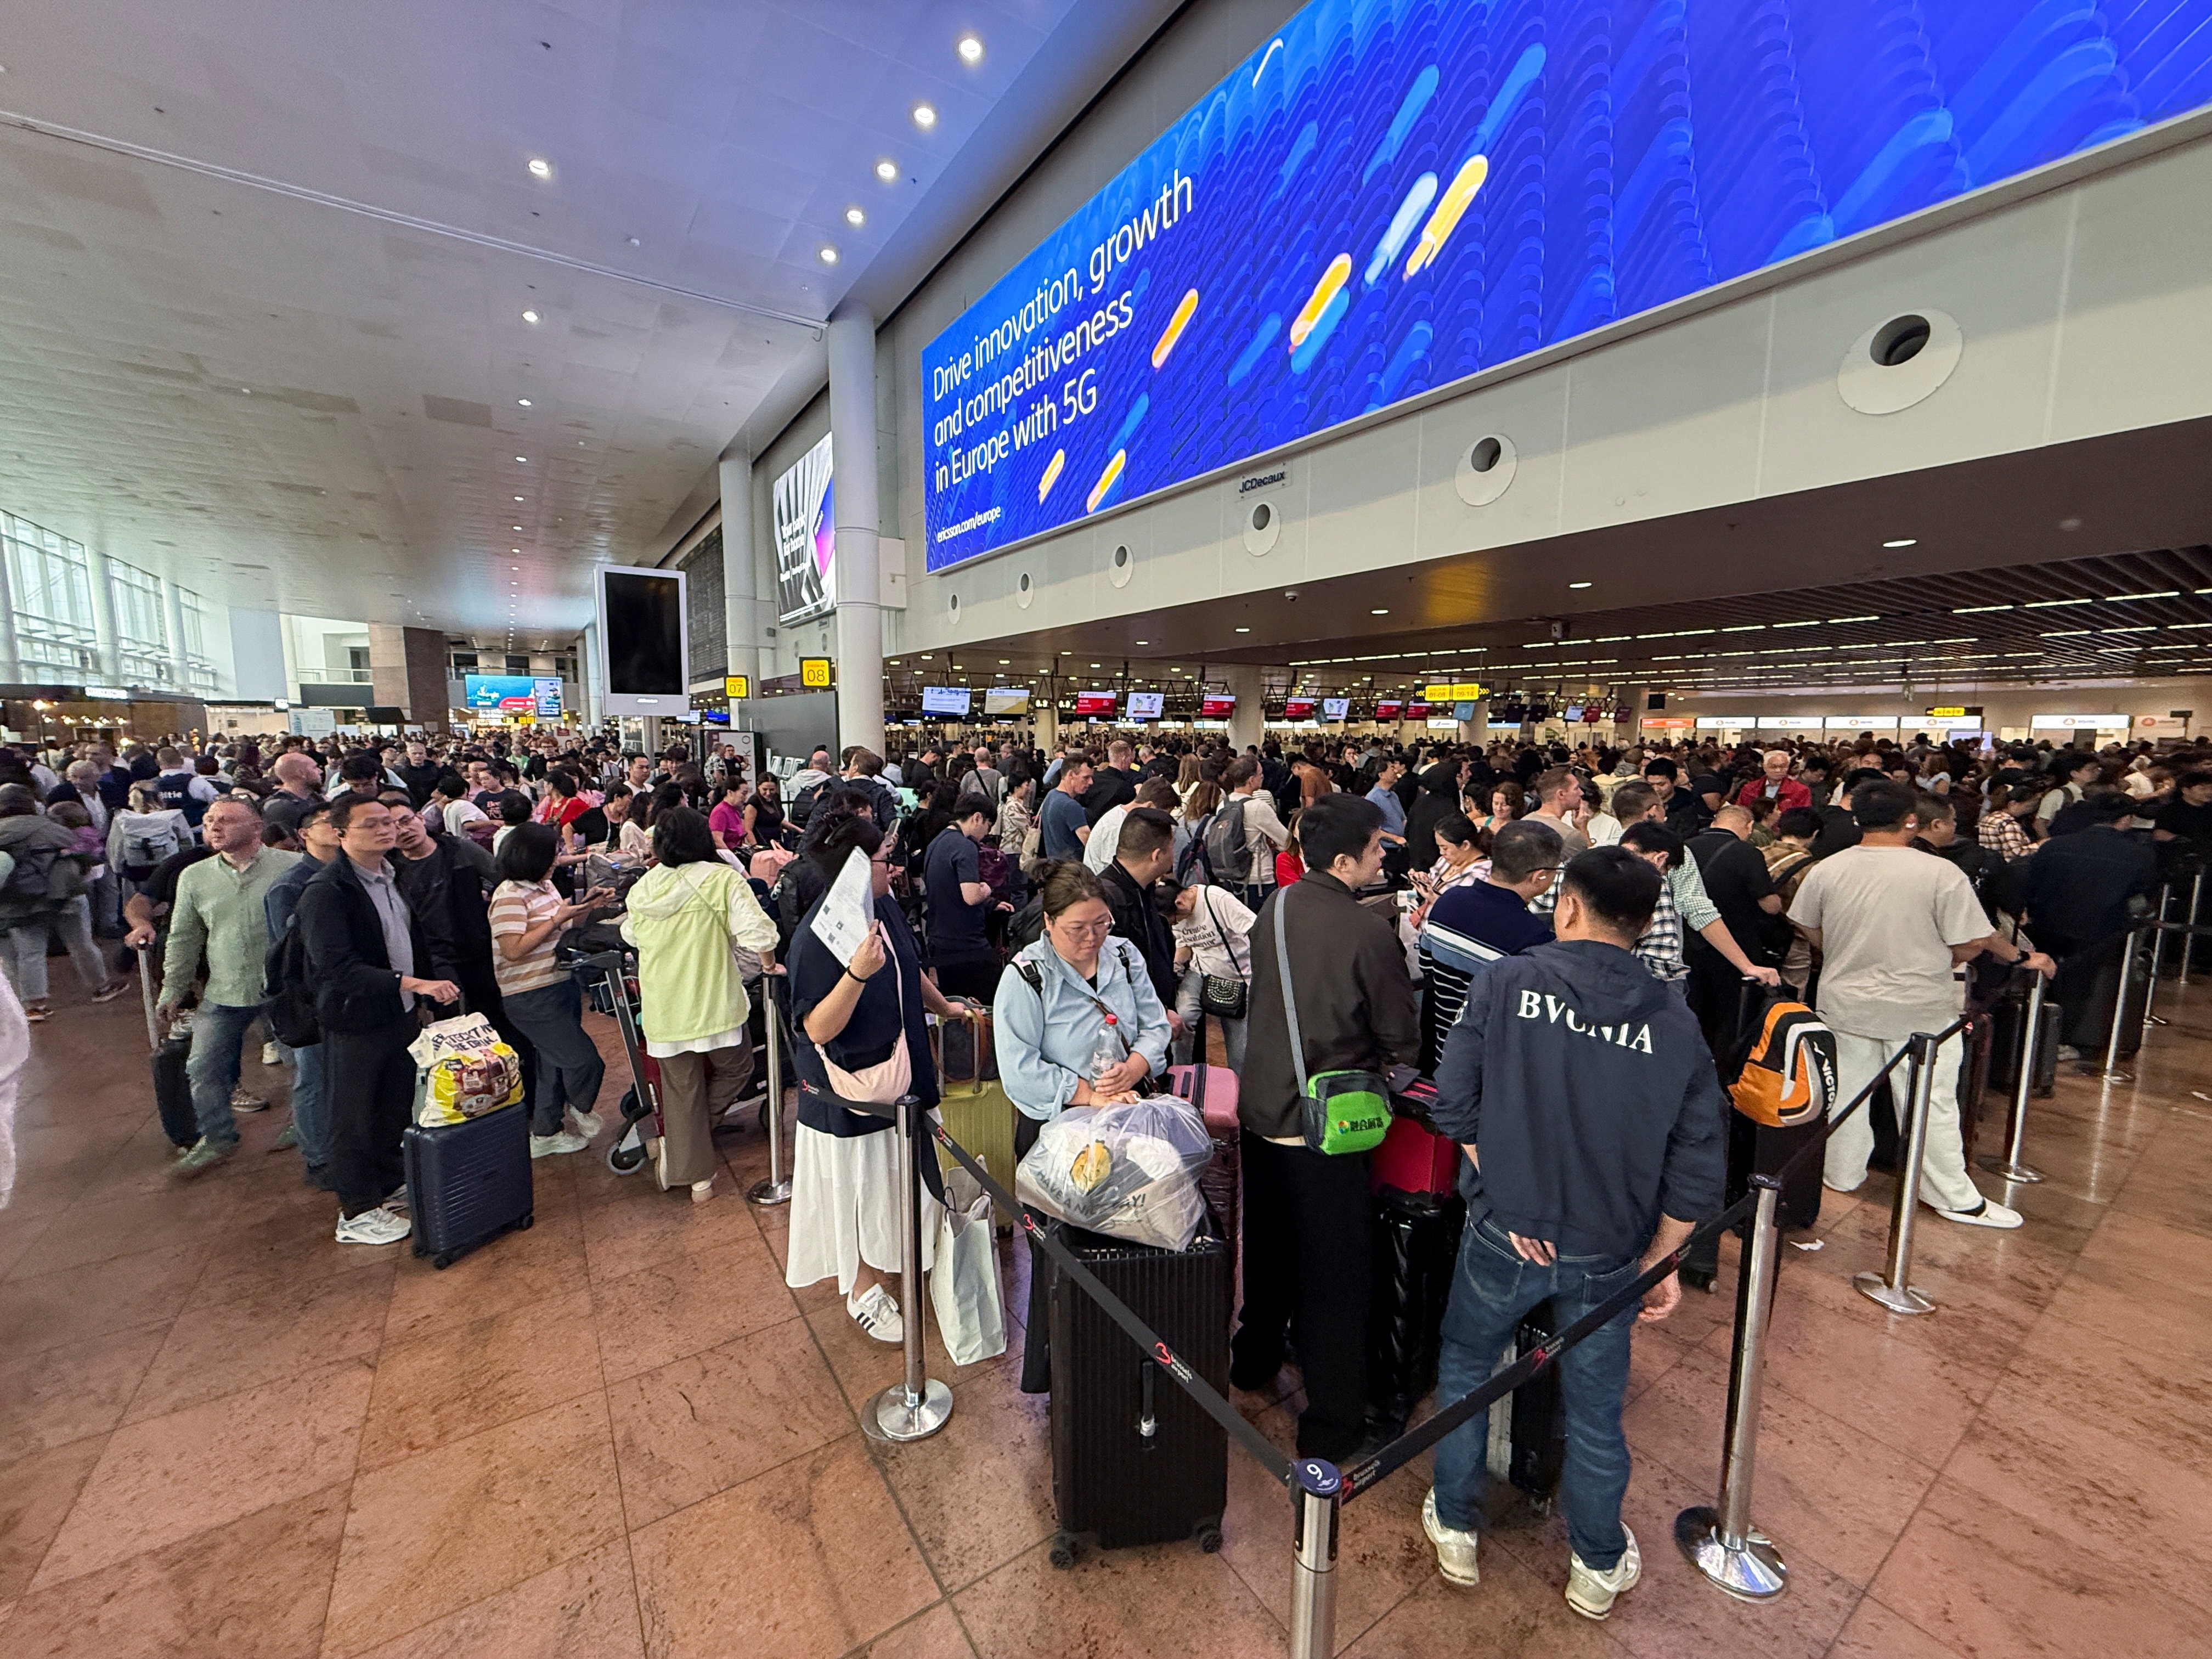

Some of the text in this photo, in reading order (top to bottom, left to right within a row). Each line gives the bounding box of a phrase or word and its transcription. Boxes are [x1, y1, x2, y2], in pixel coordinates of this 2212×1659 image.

[934, 168, 1193, 402] Drive innovation, growth
[935, 291, 1133, 447] and competitiveness
[935, 368, 1096, 493] in Europe with 5G
[1239, 471, 1285, 493] JCDecaux
[781, 522, 793, 539] Your
[937, 506, 1001, 543] ericsson.com/europe
[791, 534, 805, 553] home
[807, 669, 825, 682] 08
[729, 684, 743, 693] 07
[1306, 1464, 1323, 1481] 9
